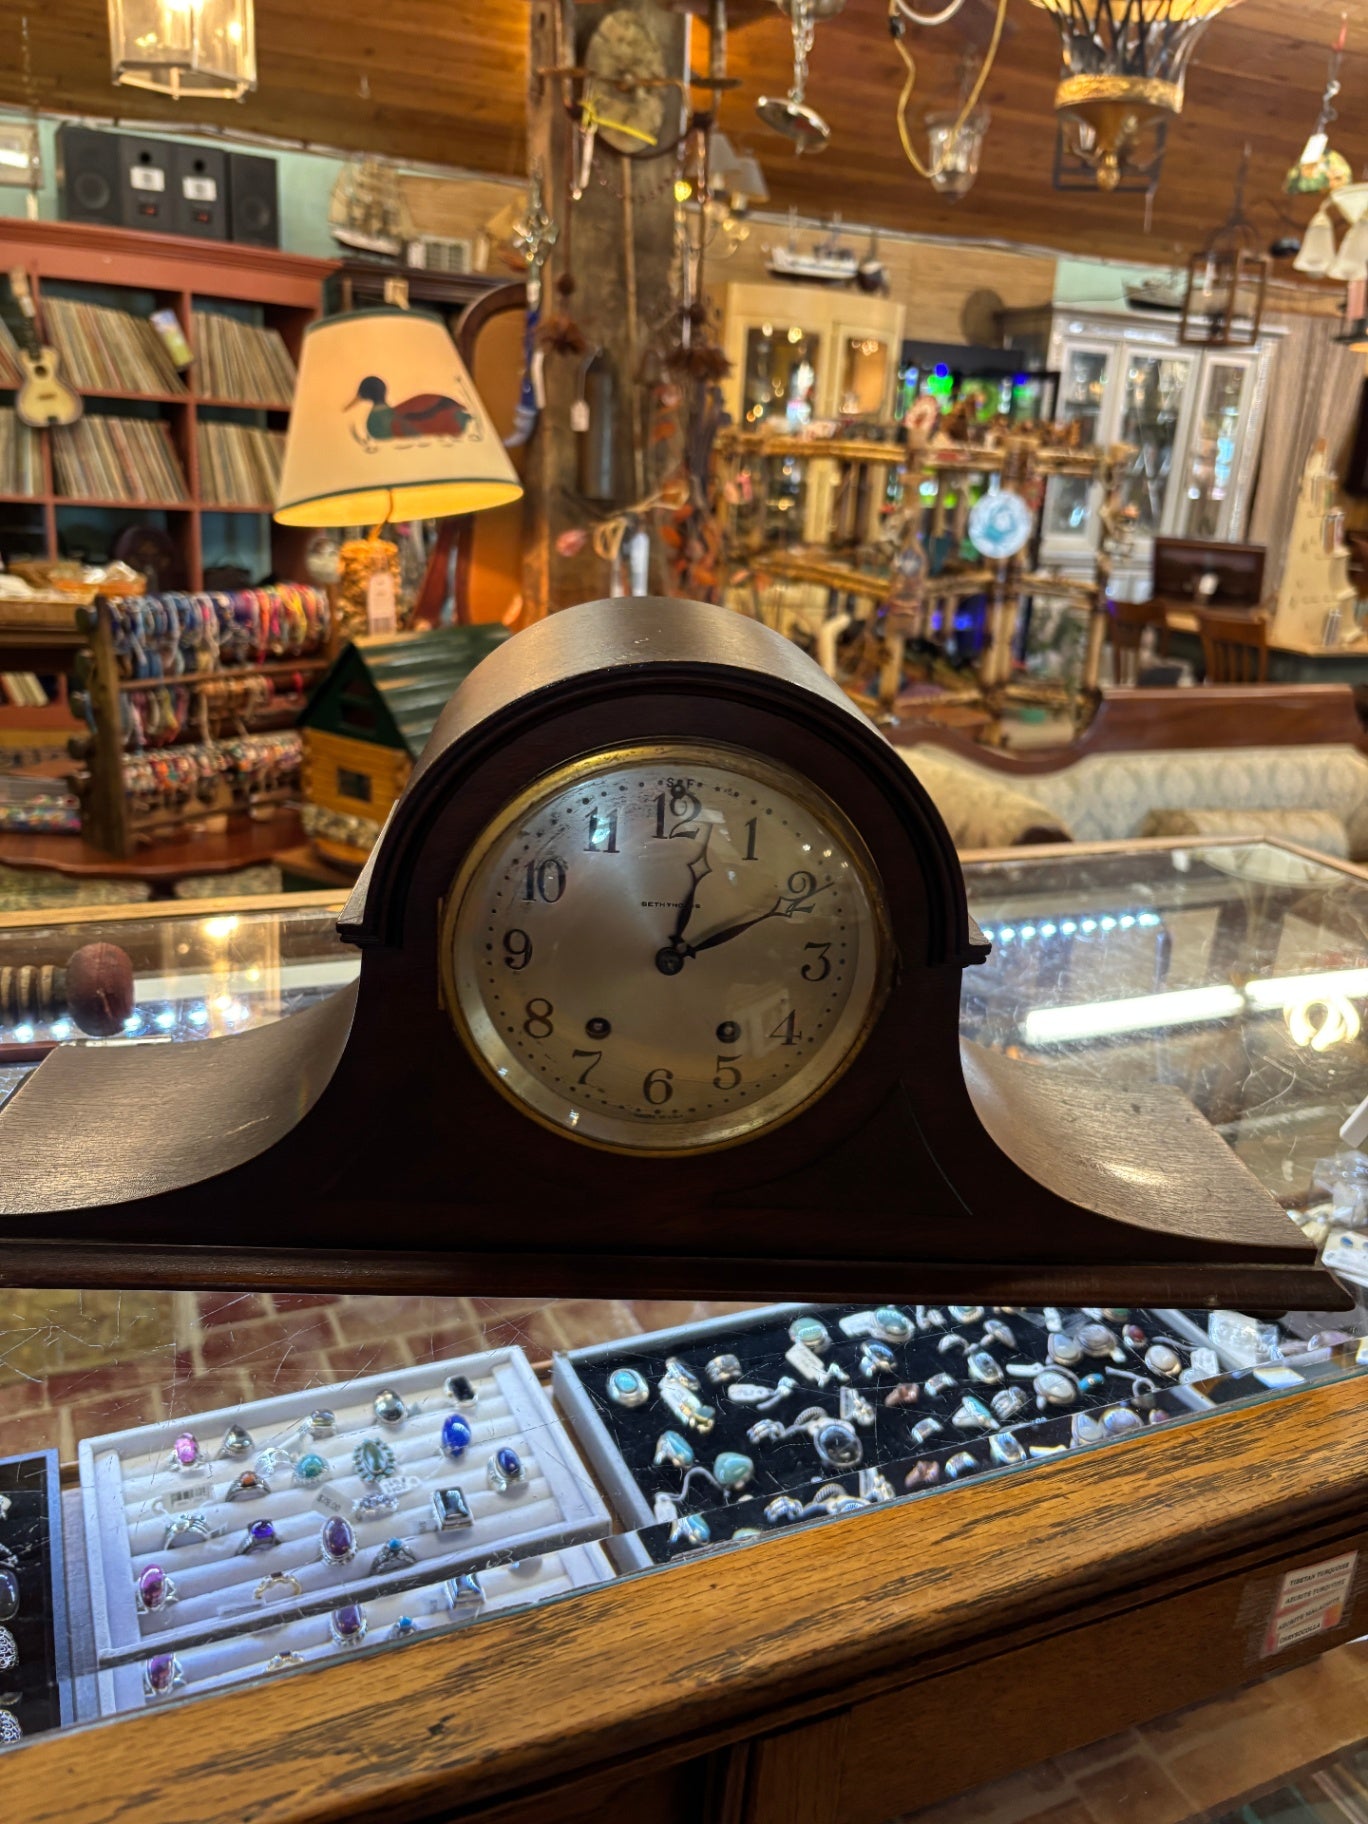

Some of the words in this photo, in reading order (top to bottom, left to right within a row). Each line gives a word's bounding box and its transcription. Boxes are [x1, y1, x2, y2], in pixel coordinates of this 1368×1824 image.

[584, 806, 621, 854] 11
[652, 790, 702, 840] 12
[742, 817, 759, 861] 1
[521, 859, 567, 904] 10
[786, 871, 817, 914] 2
[503, 928, 533, 970] 9
[801, 942, 831, 982] 3
[524, 998, 554, 1039] 8
[770, 1009, 803, 1046] 4
[571, 1050, 603, 1086] 7
[642, 1068, 674, 1105] 6
[712, 1055, 743, 1091] 5
[1290, 1574, 1315, 1586] TIBETAN
